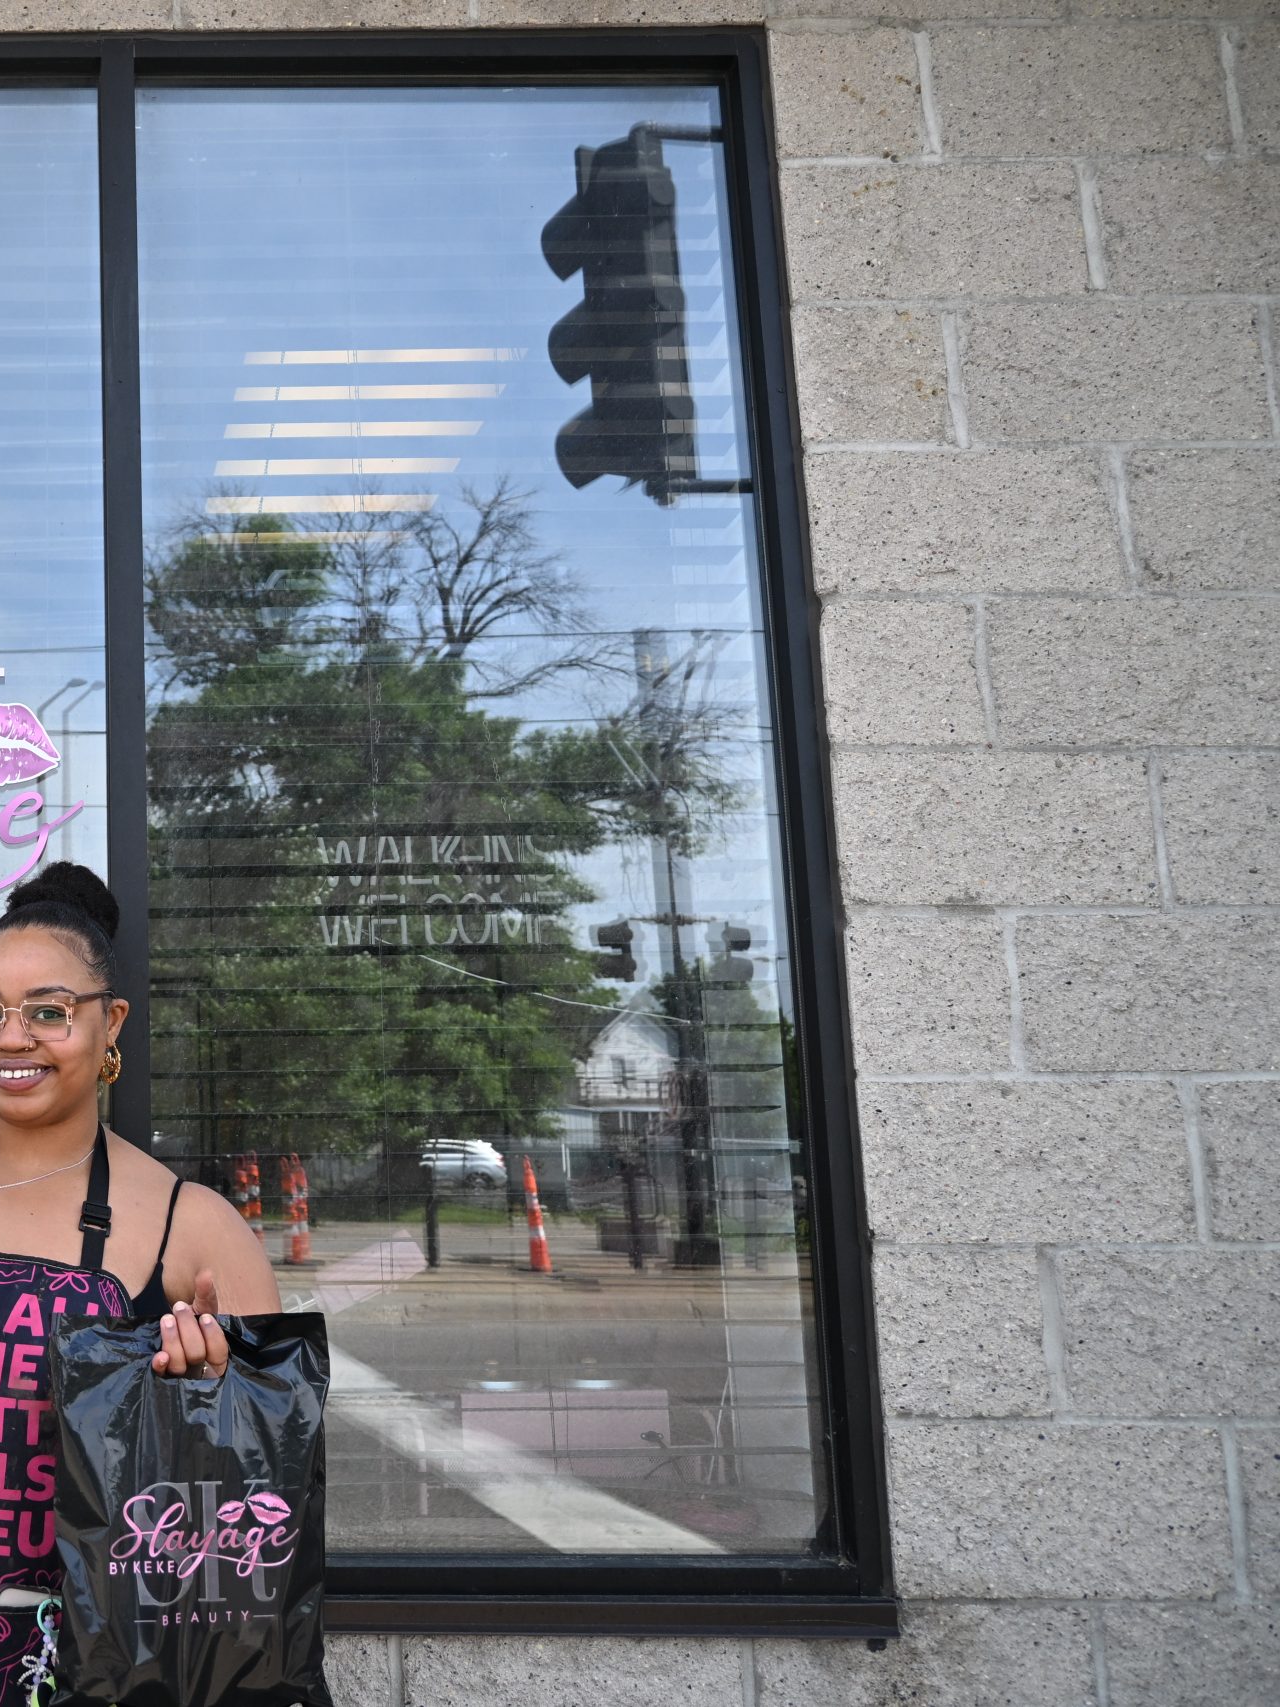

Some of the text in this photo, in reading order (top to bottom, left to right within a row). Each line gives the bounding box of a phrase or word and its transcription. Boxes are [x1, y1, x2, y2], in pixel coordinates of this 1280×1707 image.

[110, 1494, 300, 1579] Slayage
[109, 1560, 175, 1575] BY KEKE
[163, 1611, 249, 1626] BEAUTY
